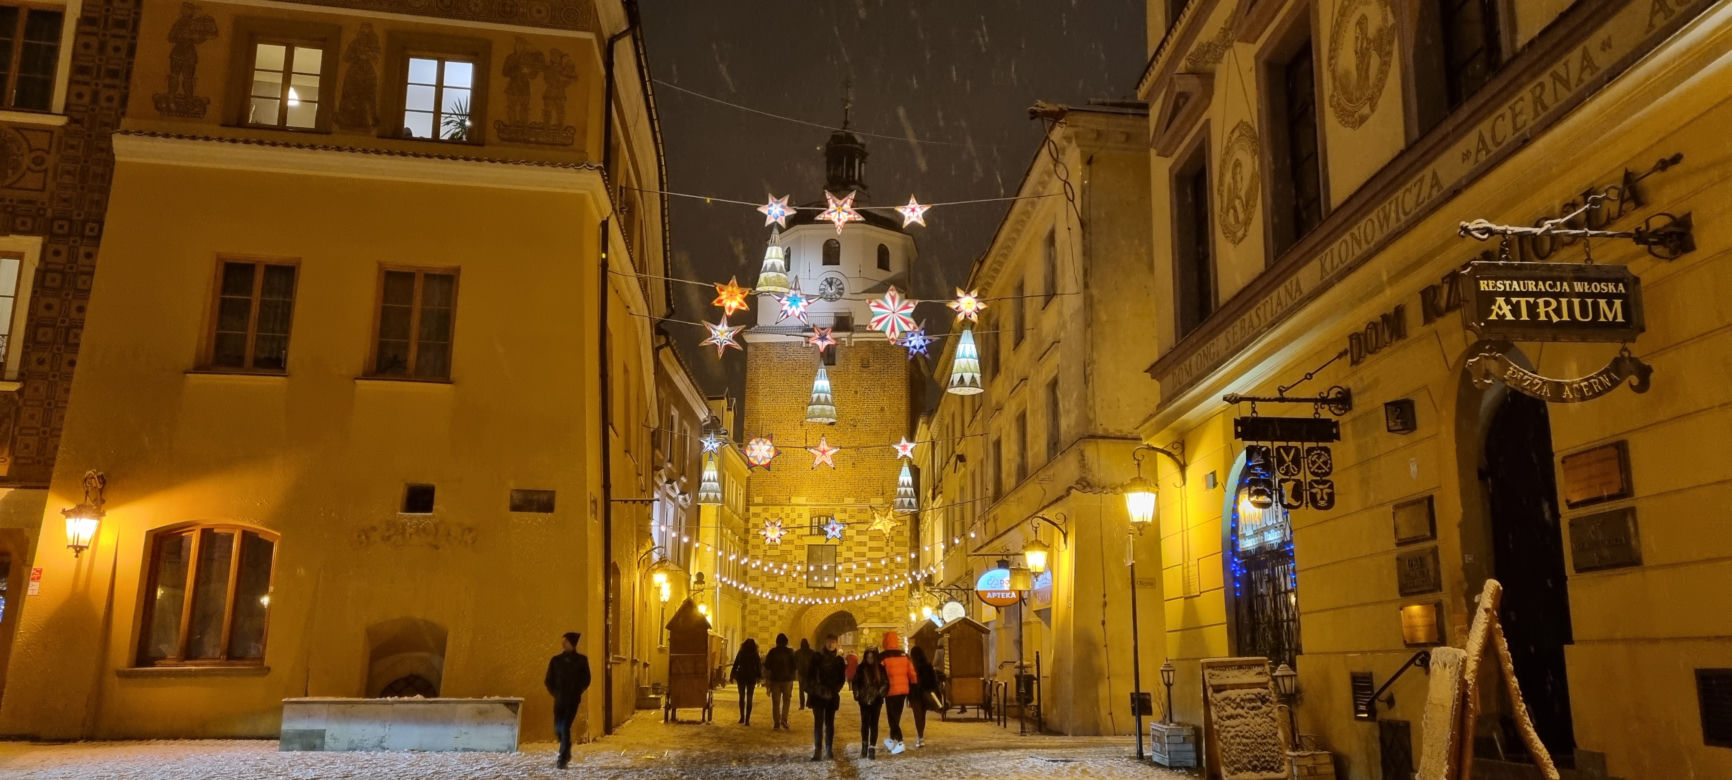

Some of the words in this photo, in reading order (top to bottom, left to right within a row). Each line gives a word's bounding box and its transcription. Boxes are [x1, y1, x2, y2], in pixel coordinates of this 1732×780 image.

[1171, 359, 1193, 388] DOM
[1224, 276, 1303, 351] SEBASTIANA
[1319, 168, 1444, 281] KLONOWICZA
[1479, 279, 1570, 293] RESTAURACJA
[1573, 280, 1626, 294] WŁOSKA
[1487, 296, 1626, 324] ATRIUM
[1348, 304, 1408, 366] DOM
[1503, 365, 1551, 398] PIZZA
[1562, 371, 1621, 399] ACERNA
[986, 591, 1017, 599] APTEKA
